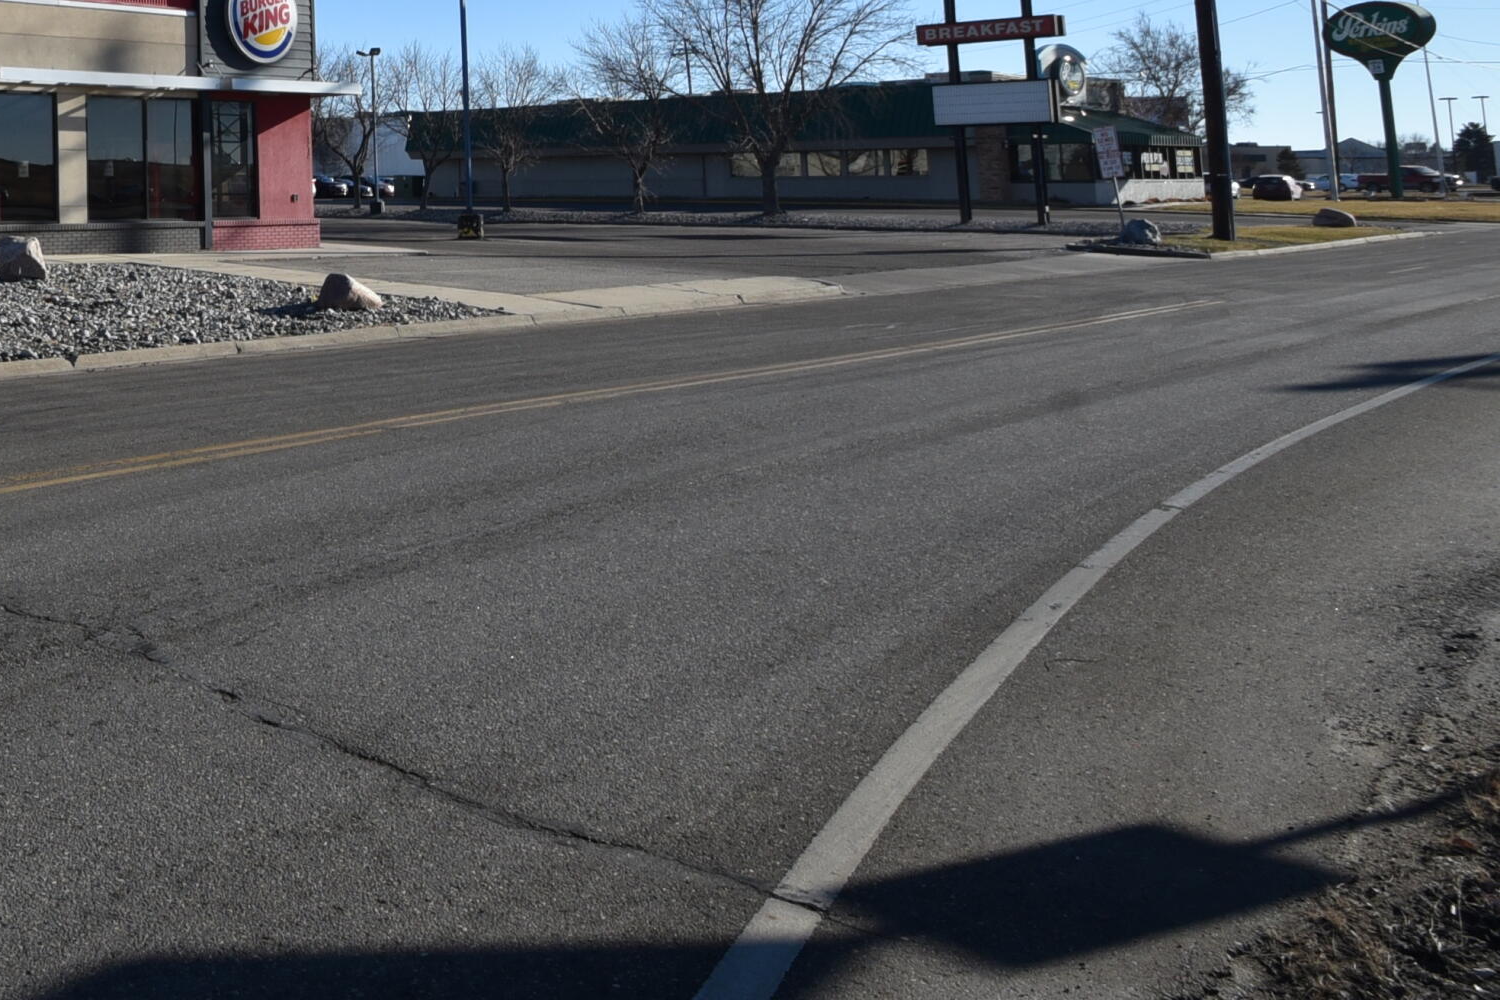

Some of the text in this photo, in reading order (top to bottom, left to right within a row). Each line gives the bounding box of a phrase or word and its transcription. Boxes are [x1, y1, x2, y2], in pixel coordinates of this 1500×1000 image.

[243, 4, 290, 40] KING
[925, 19, 1044, 40] BREAKFAST
[1332, 11, 1409, 42] Perkins
